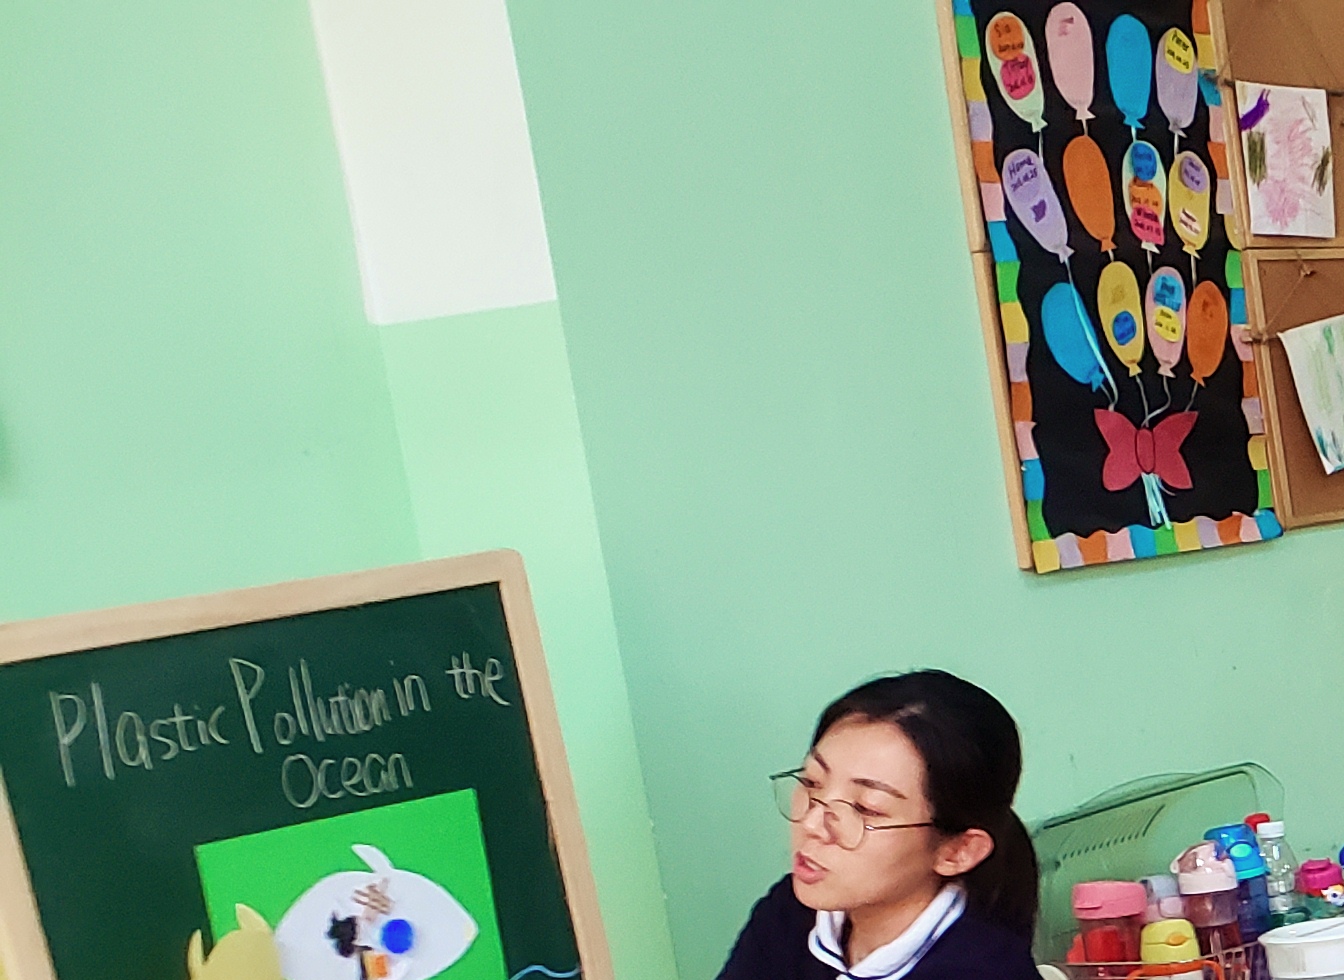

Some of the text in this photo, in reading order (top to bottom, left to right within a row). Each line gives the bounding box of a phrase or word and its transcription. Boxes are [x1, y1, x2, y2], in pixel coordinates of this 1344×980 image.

[48, 650, 512, 787] Plastic Pollution in the
[280, 751, 415, 808] Ocean
